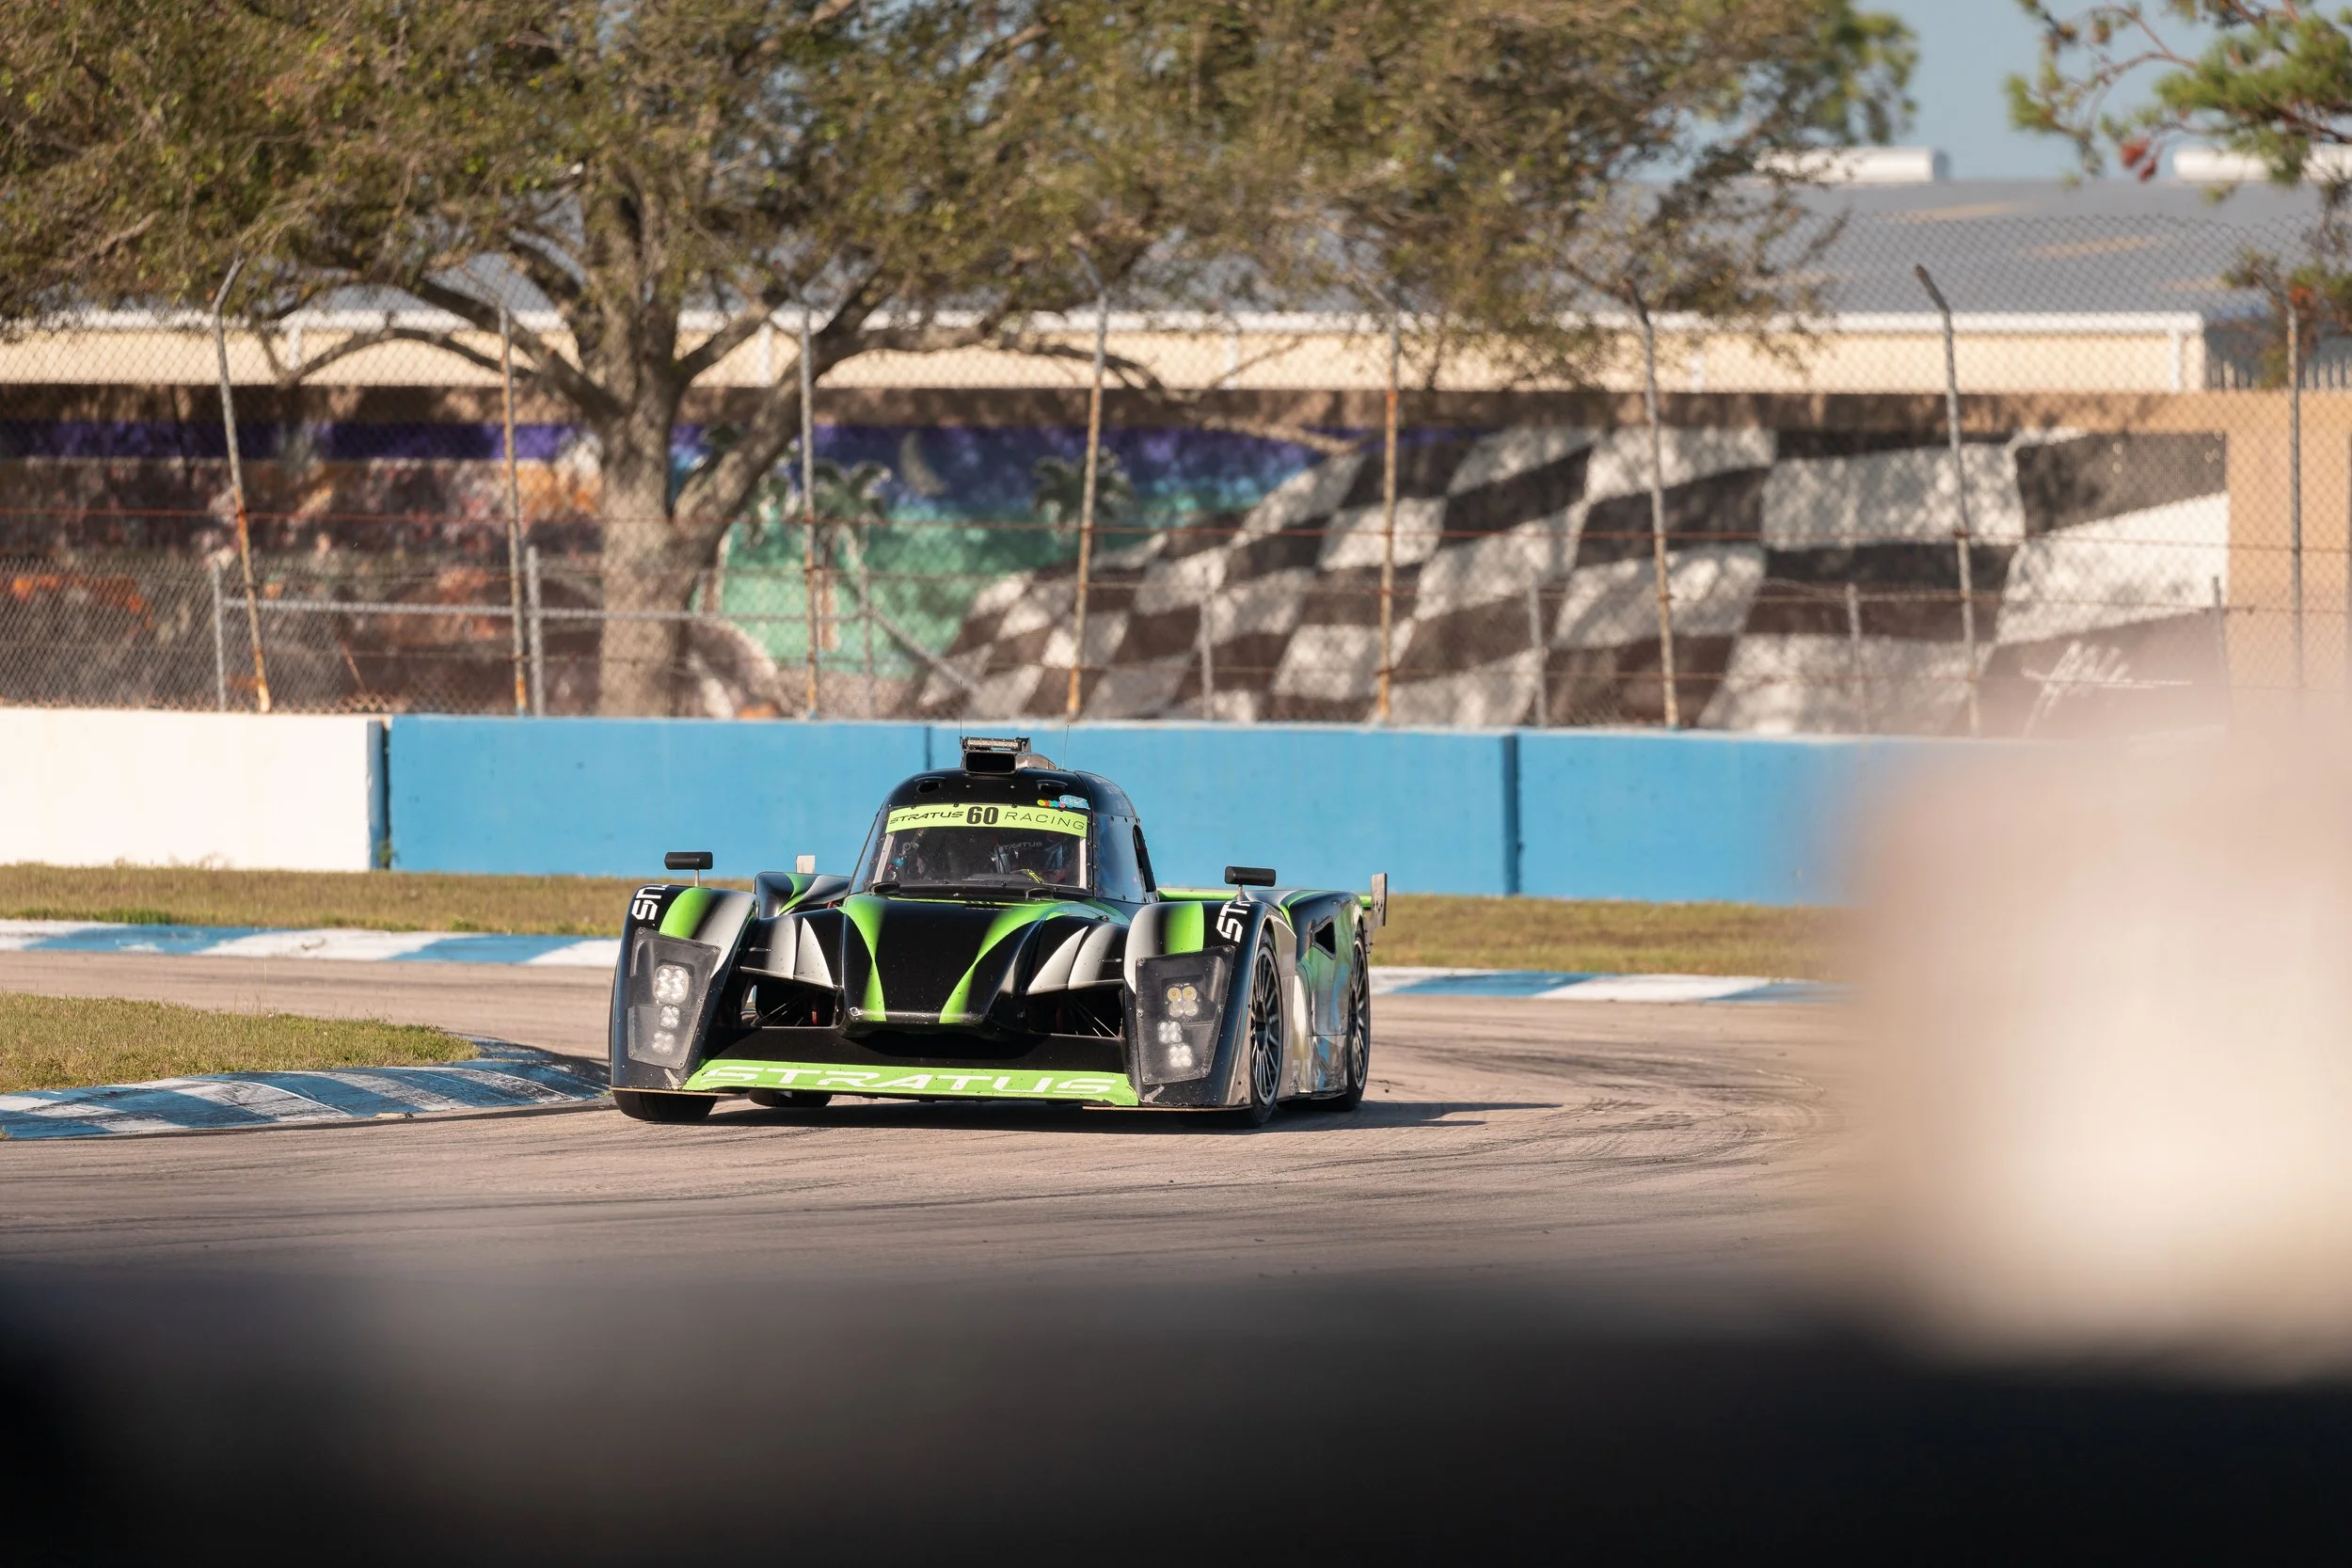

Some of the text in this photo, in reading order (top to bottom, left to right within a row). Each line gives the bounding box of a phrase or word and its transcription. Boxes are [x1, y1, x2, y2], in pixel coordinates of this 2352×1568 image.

[889, 805, 1085, 831] STRATUS 60 RACING
[700, 1066, 1118, 1094] STRATUS
